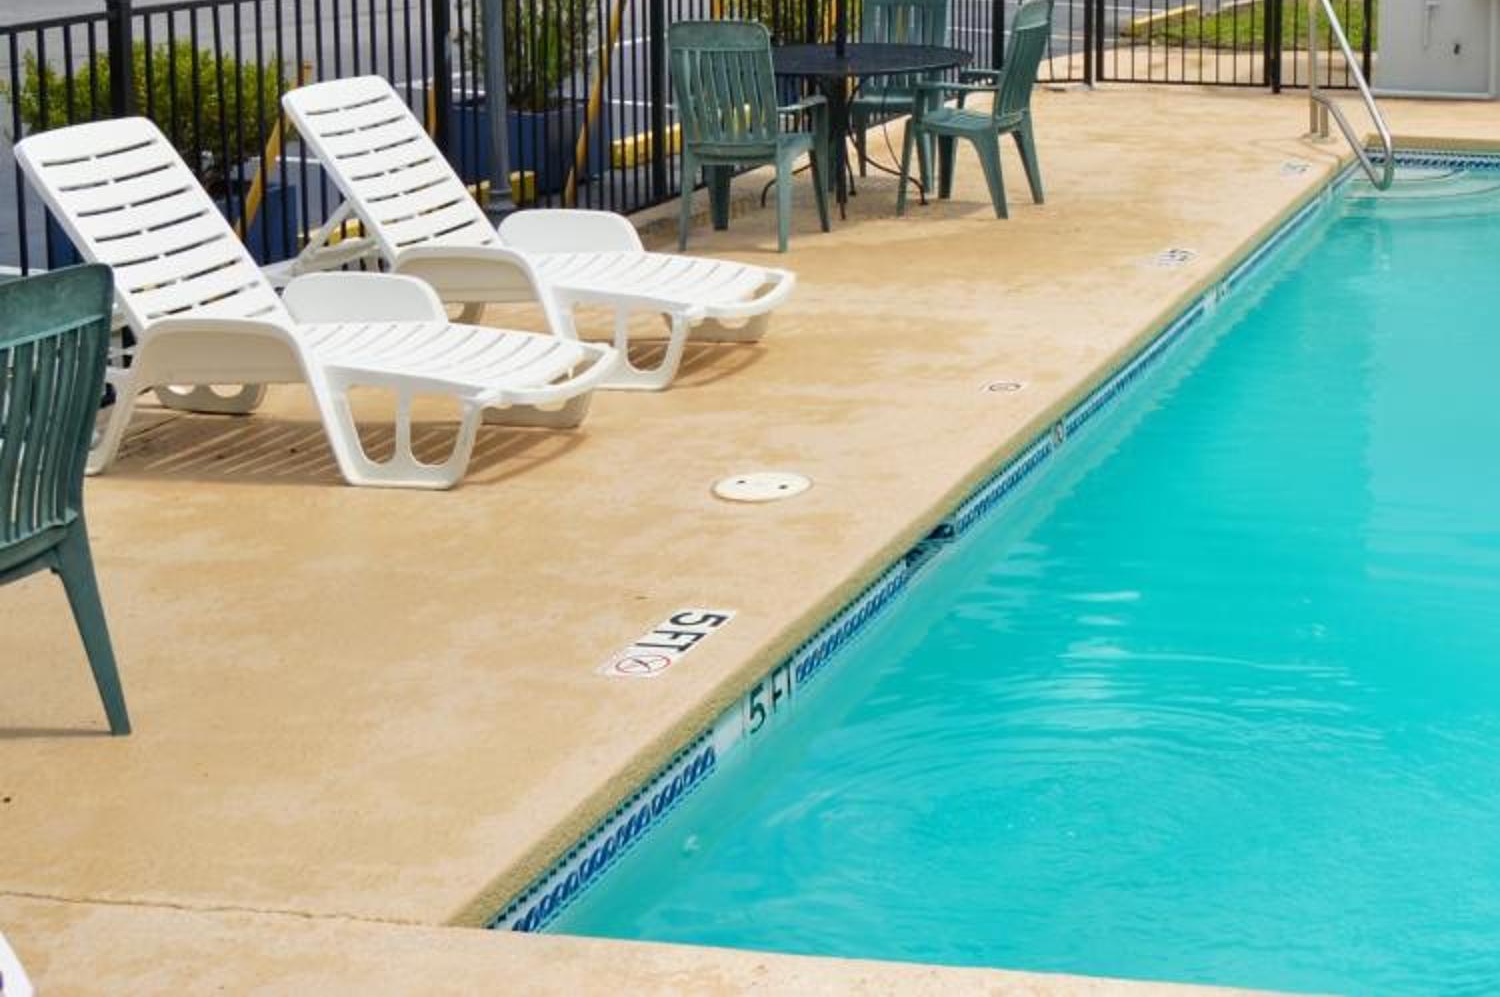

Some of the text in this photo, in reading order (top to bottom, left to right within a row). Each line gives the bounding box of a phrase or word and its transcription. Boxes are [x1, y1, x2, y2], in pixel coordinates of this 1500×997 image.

[634, 611, 729, 653] 5 FT
[749, 656, 794, 735] 5 FT
